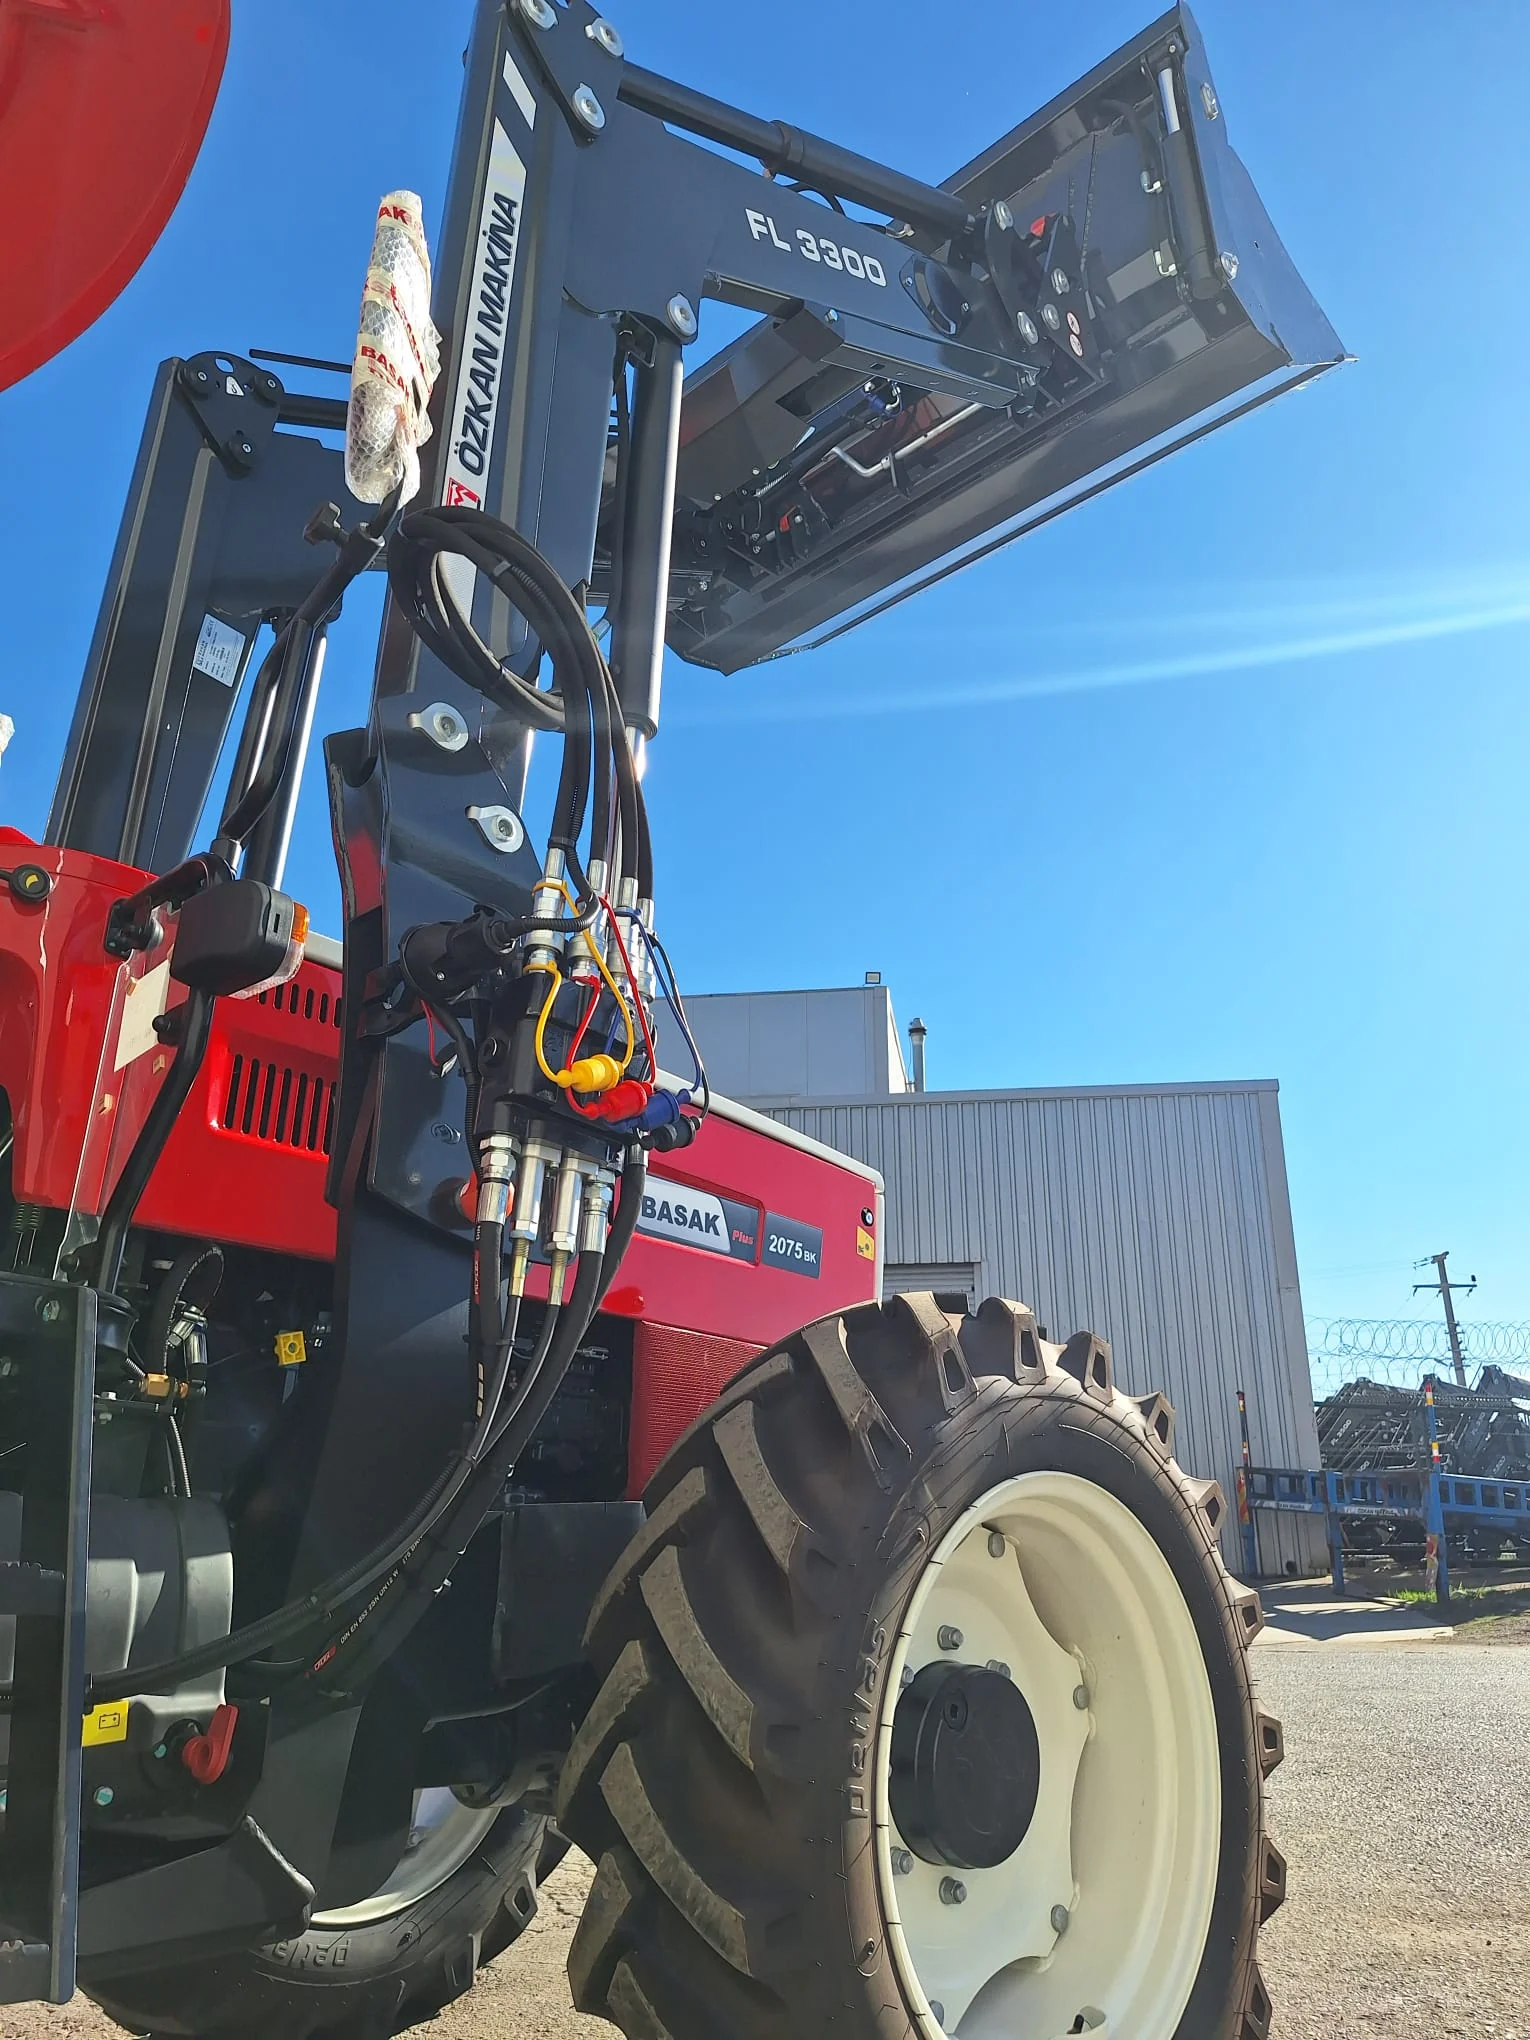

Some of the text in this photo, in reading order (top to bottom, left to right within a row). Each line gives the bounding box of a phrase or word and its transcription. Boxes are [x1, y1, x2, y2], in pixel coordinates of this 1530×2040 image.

[745, 208, 887, 287] FL 3300
[453, 333, 501, 477] ÖZKAN
[641, 1196, 721, 1237] BASAK
[768, 1234, 817, 1264] 2075 BK
